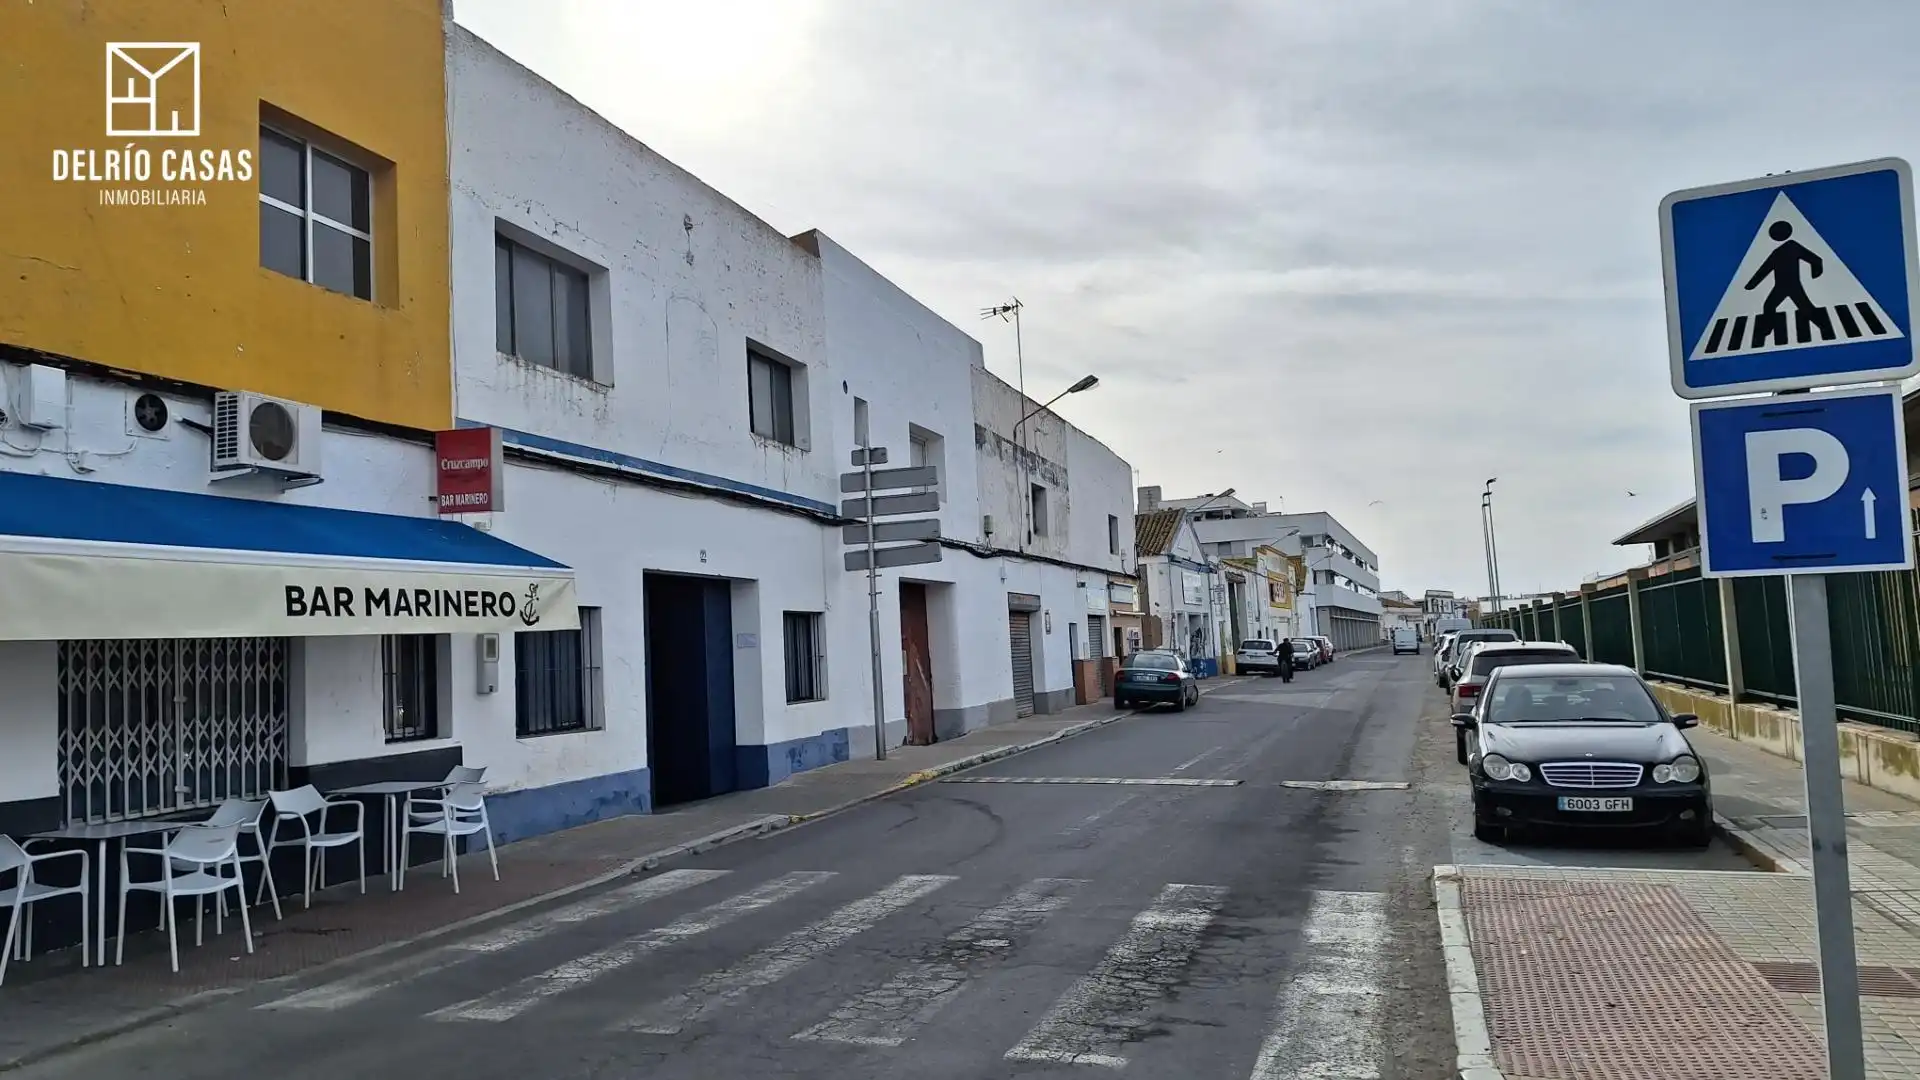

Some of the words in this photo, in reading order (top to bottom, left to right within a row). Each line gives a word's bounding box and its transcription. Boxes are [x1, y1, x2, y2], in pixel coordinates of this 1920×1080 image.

[441, 458, 489, 470] Cruzcampo
[1745, 428, 1850, 543] P
[441, 494, 455, 507] BAR
[456, 492, 488, 506] MARINERO
[285, 585, 356, 617] BAR
[364, 587, 516, 617] MARINERO
[1567, 799, 1600, 810] 6003
[1605, 799, 1630, 810] GFH
